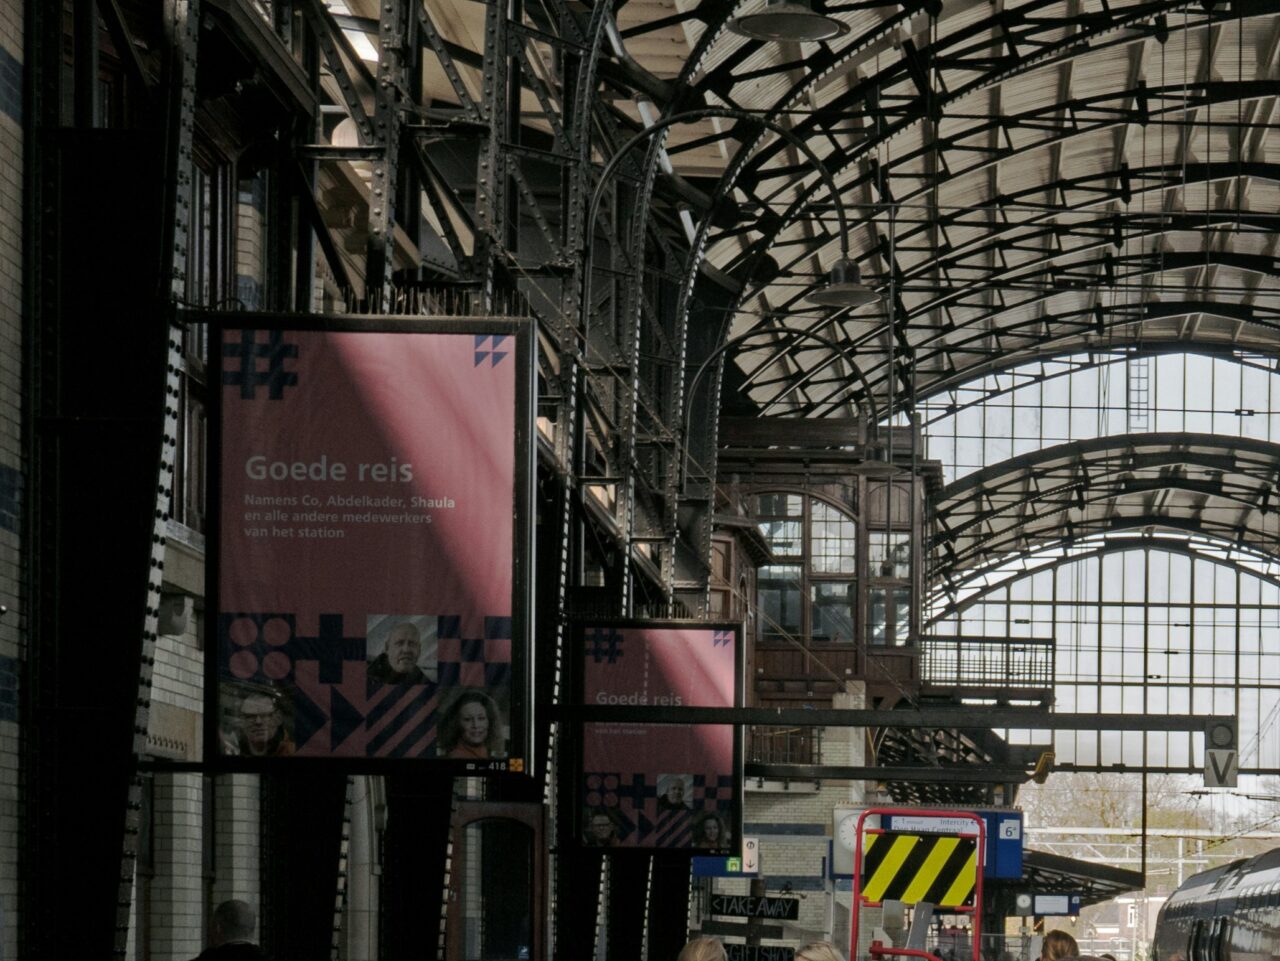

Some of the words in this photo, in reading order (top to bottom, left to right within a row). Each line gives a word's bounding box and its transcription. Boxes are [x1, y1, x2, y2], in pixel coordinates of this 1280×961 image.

[245, 455, 347, 481] Goede
[358, 457, 413, 482] reis
[244, 494, 297, 506] Namens
[302, 494, 323, 508] Co,
[326, 495, 407, 509] Abdelkader,
[410, 496, 456, 509] Shaula
[244, 512, 260, 521] en
[265, 509, 288, 522] alle
[292, 510, 339, 522] andere
[342, 511, 433, 524] medewerkers
[244, 527, 268, 537] van
[272, 526, 293, 537] het
[297, 526, 345, 538] station
[595, 691, 648, 705] Goede
[654, 692, 683, 706] reis
[1208, 751, 1235, 785] V
